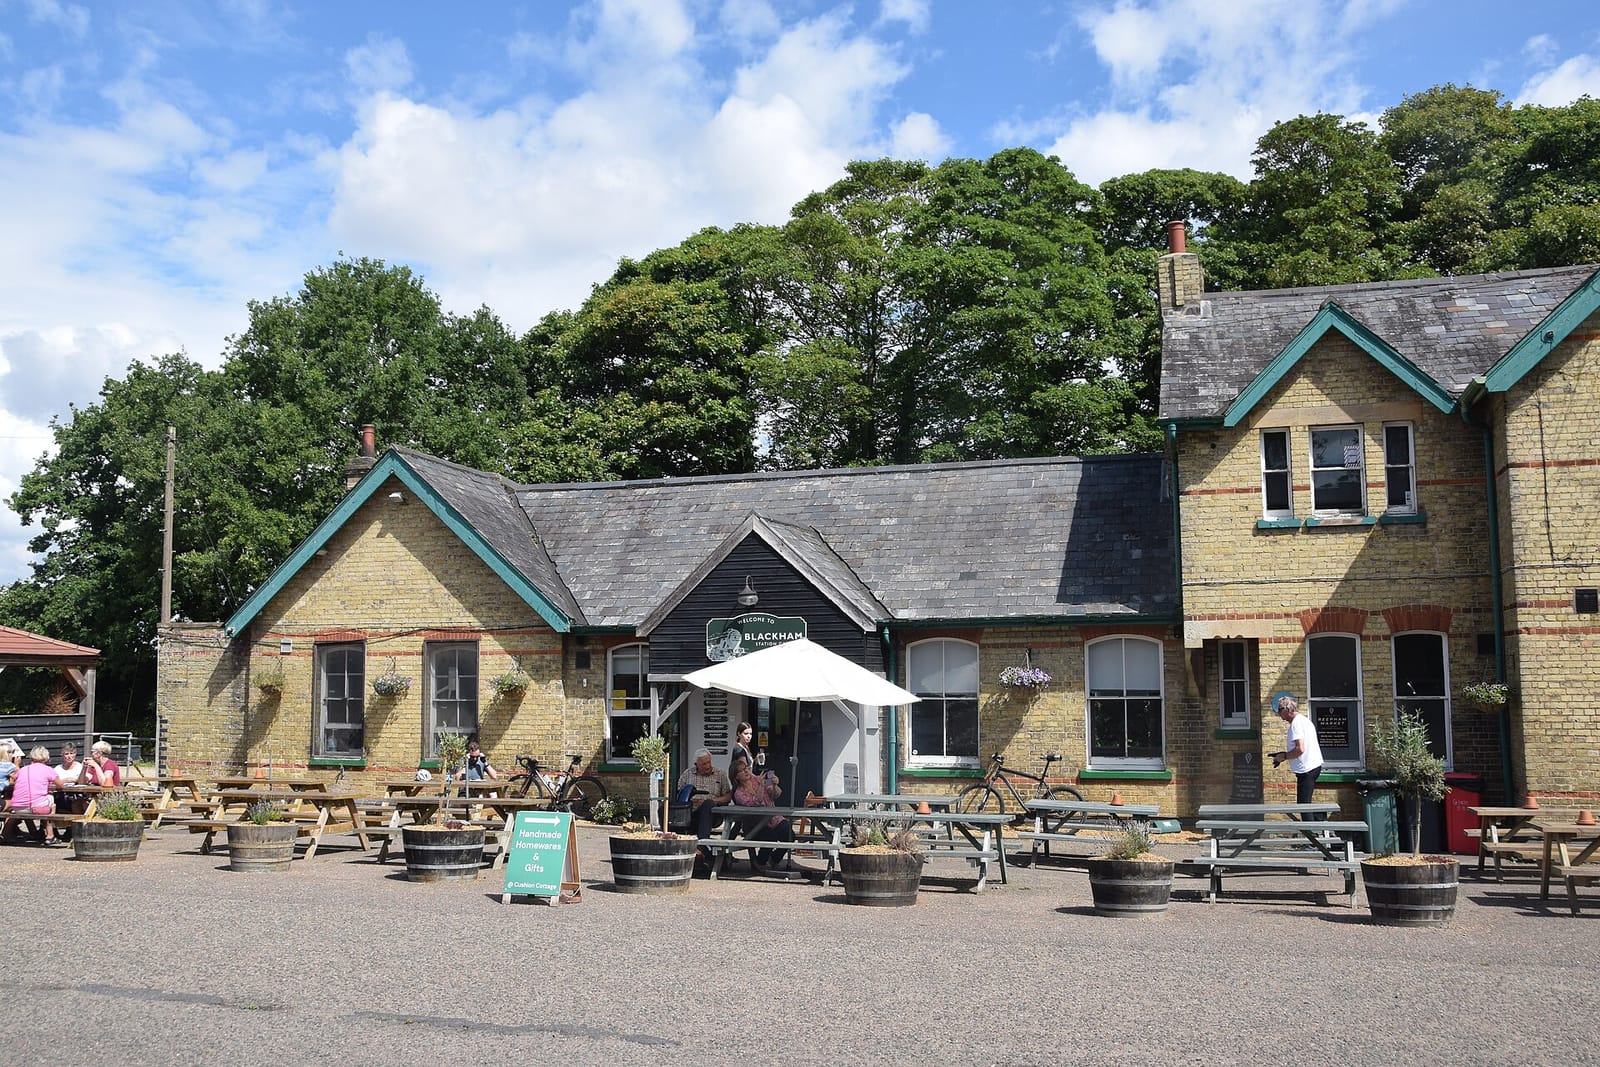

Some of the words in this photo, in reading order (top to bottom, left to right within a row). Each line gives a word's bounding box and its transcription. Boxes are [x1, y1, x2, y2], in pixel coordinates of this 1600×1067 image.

[744, 632, 802, 640] BLACKHAM
[520, 829, 562, 838] Handmade
[516, 840, 562, 850] Homewares
[533, 852, 540, 860] &
[524, 864, 544, 872] Gifts
